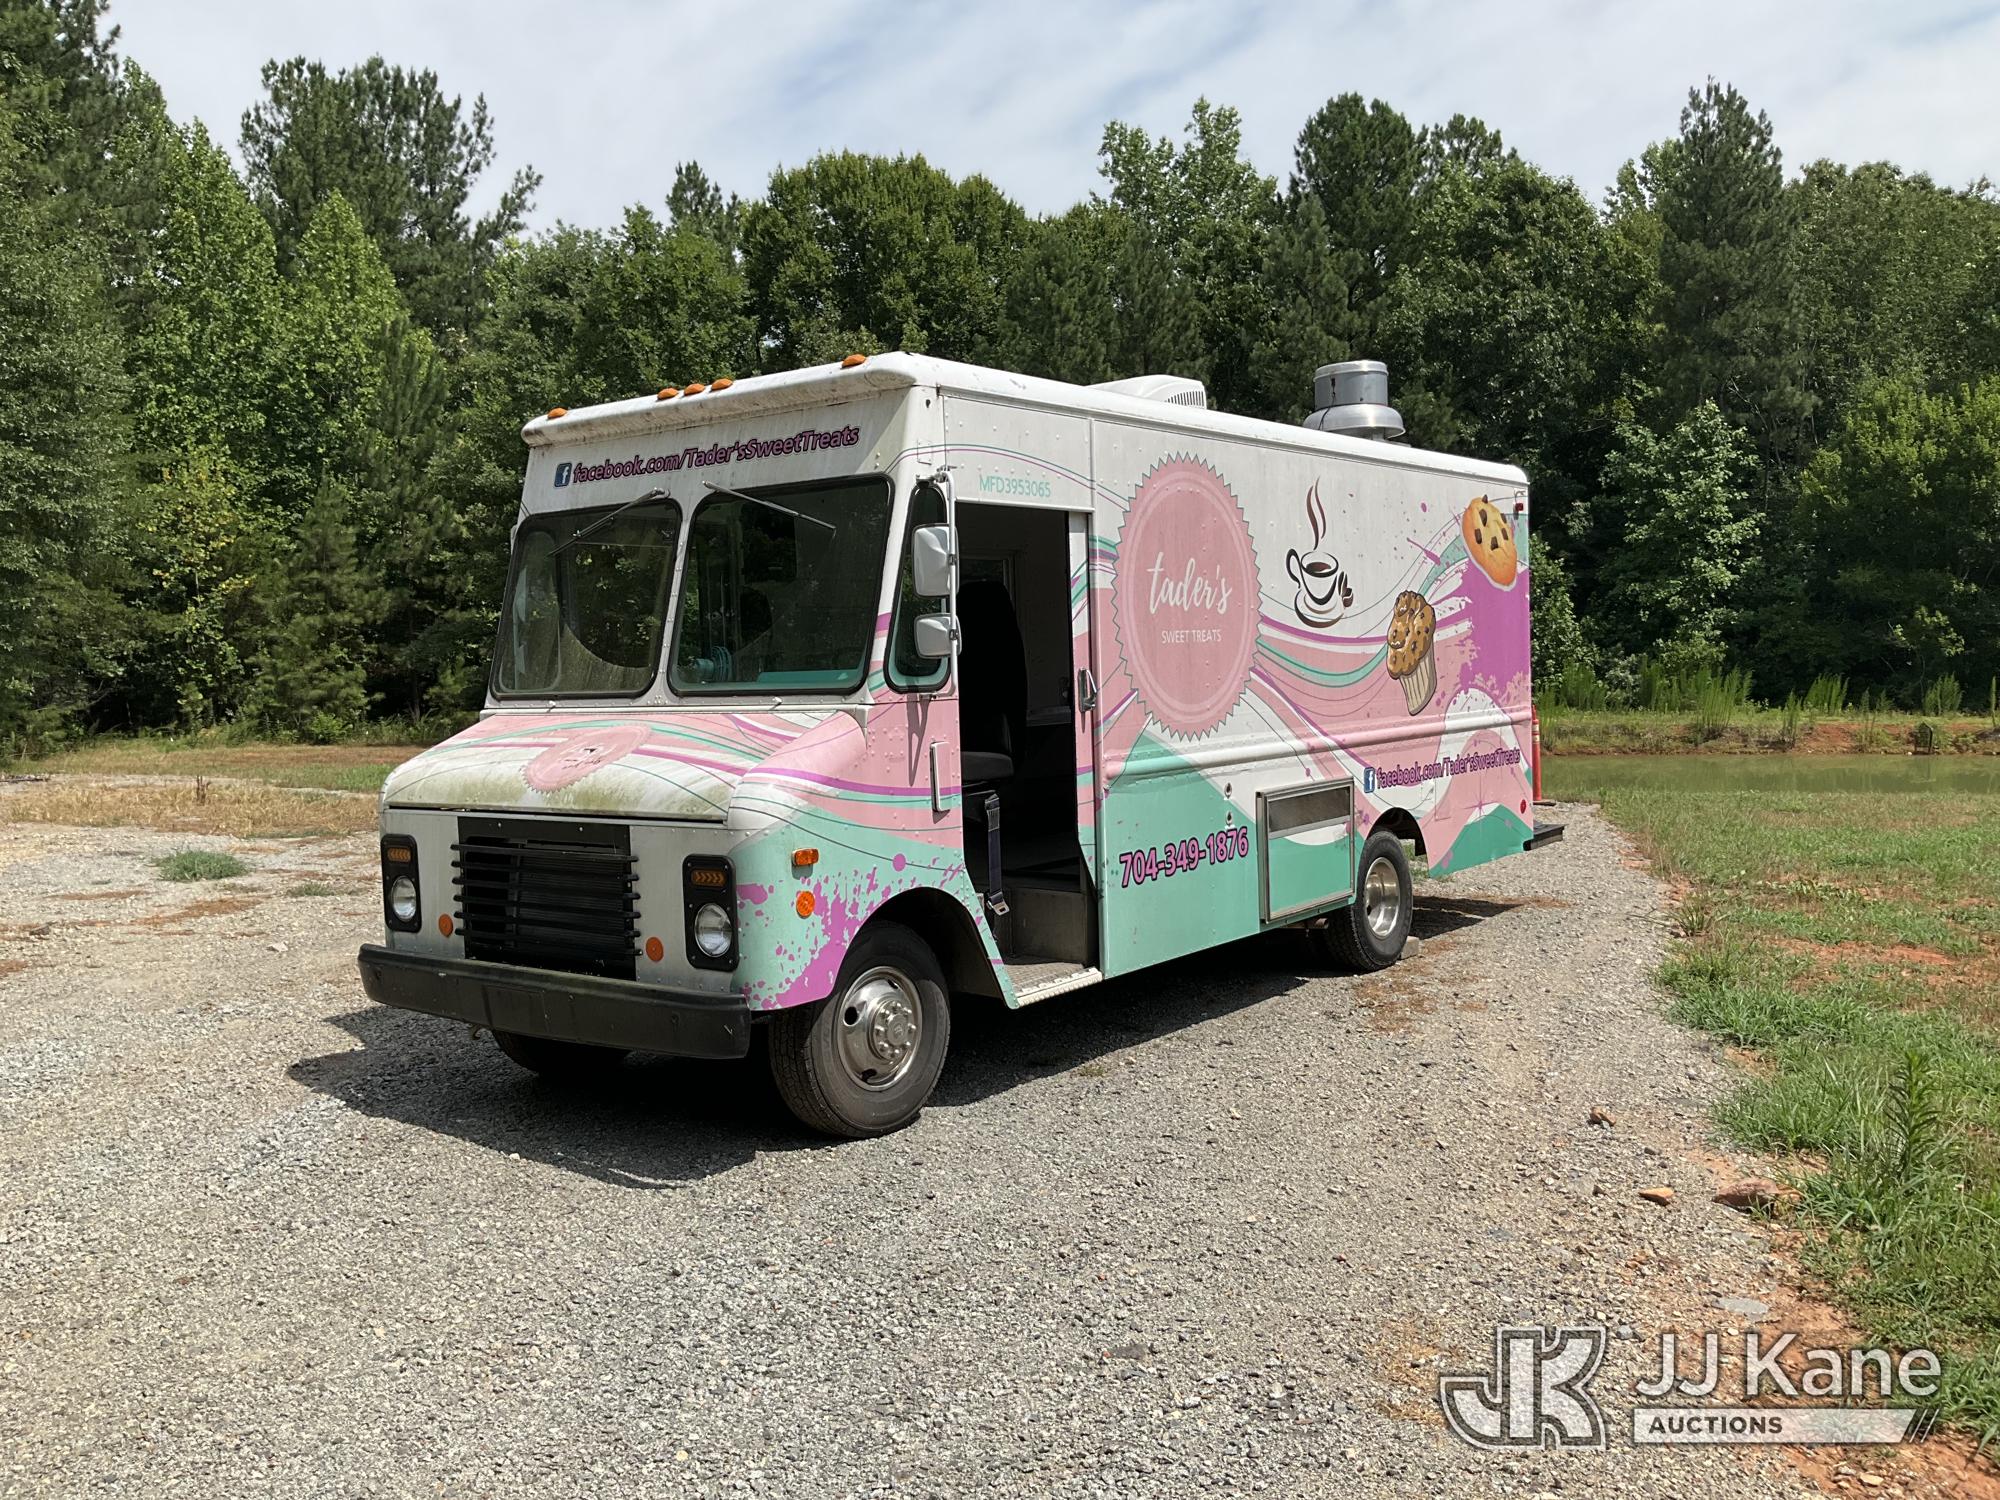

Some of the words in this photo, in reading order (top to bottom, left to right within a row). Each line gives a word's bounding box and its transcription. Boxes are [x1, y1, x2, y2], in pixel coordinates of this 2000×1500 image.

[572, 424, 860, 484] facebook.com/Tader'sSweetTreats
[979, 474, 1051, 497] MFD3953065
[1146, 551, 1233, 615] tader's
[1161, 629, 1190, 644] SWEET
[1191, 628, 1223, 643] TREATS
[1376, 747, 1522, 790] facebook.com/Tader'sSweetTreats
[1118, 826, 1250, 888] 704-349-1876
